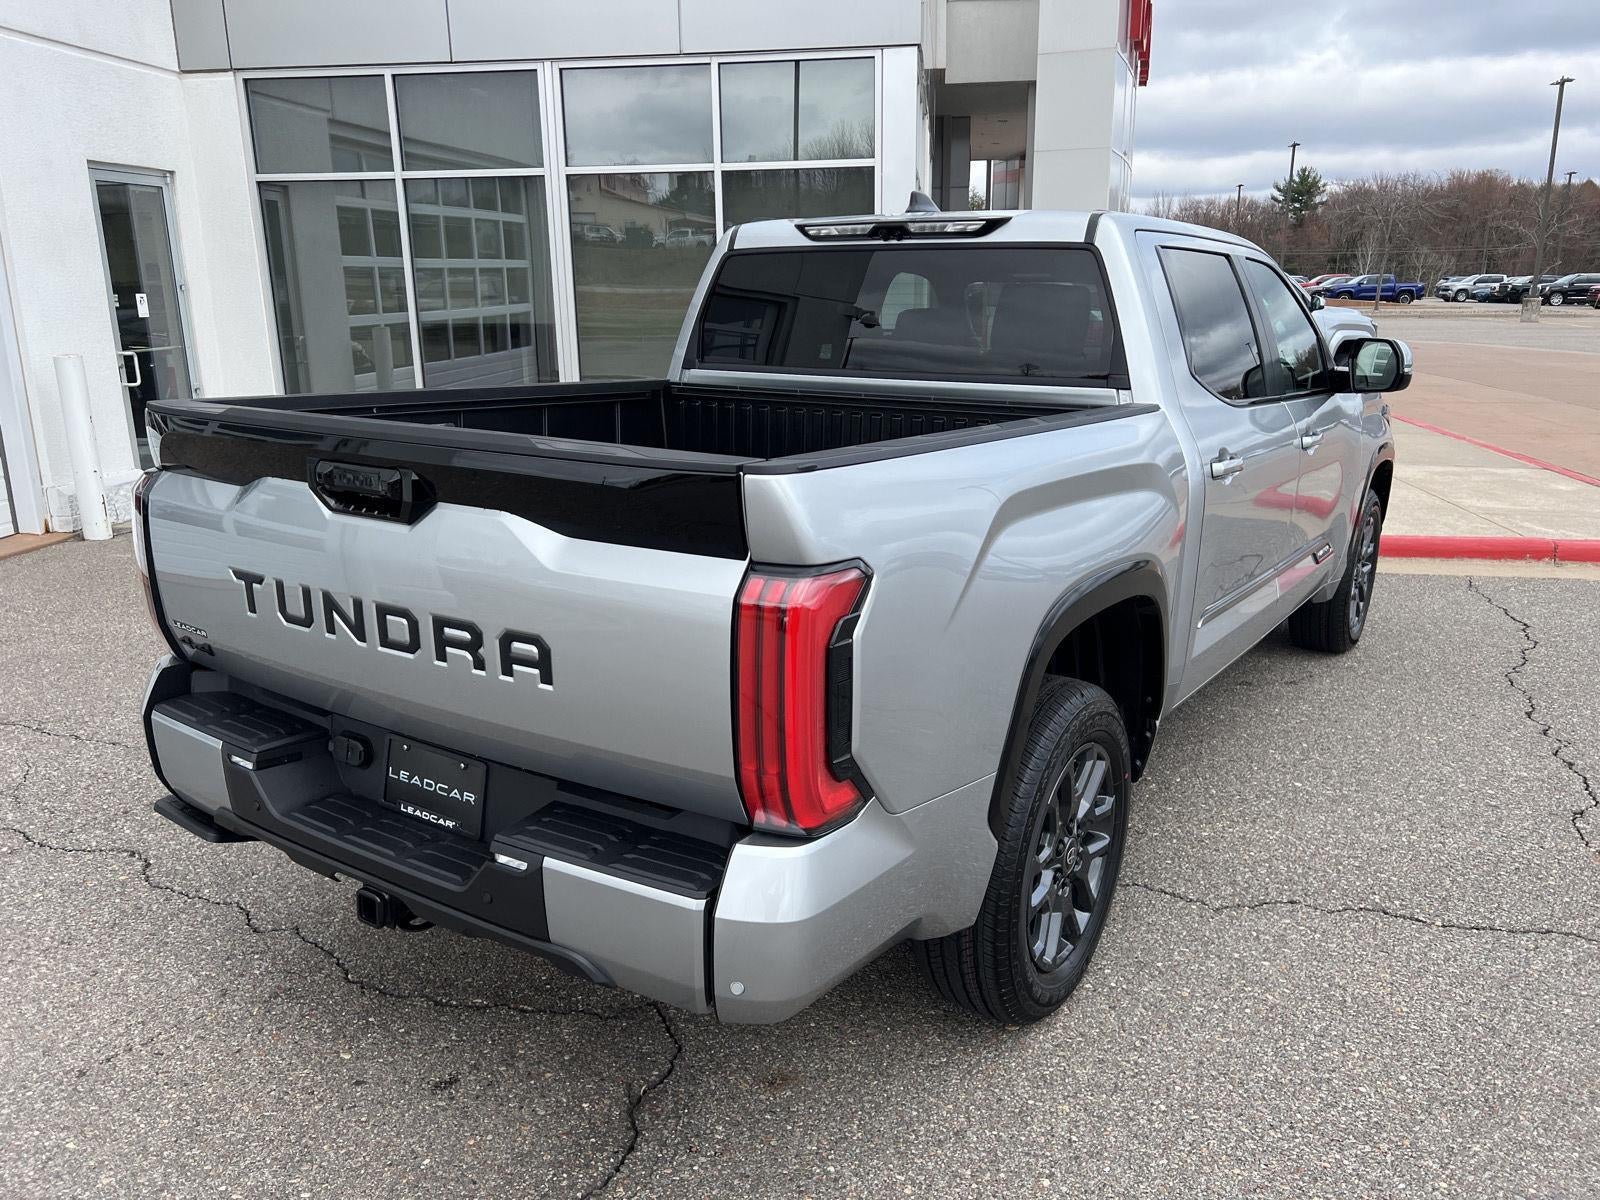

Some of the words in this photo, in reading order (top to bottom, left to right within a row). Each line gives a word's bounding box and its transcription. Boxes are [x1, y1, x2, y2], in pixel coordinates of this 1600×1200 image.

[228, 566, 554, 691] TUNDRA
[388, 766, 475, 805] LEADCAR
[400, 803, 454, 829] LEADCAR
